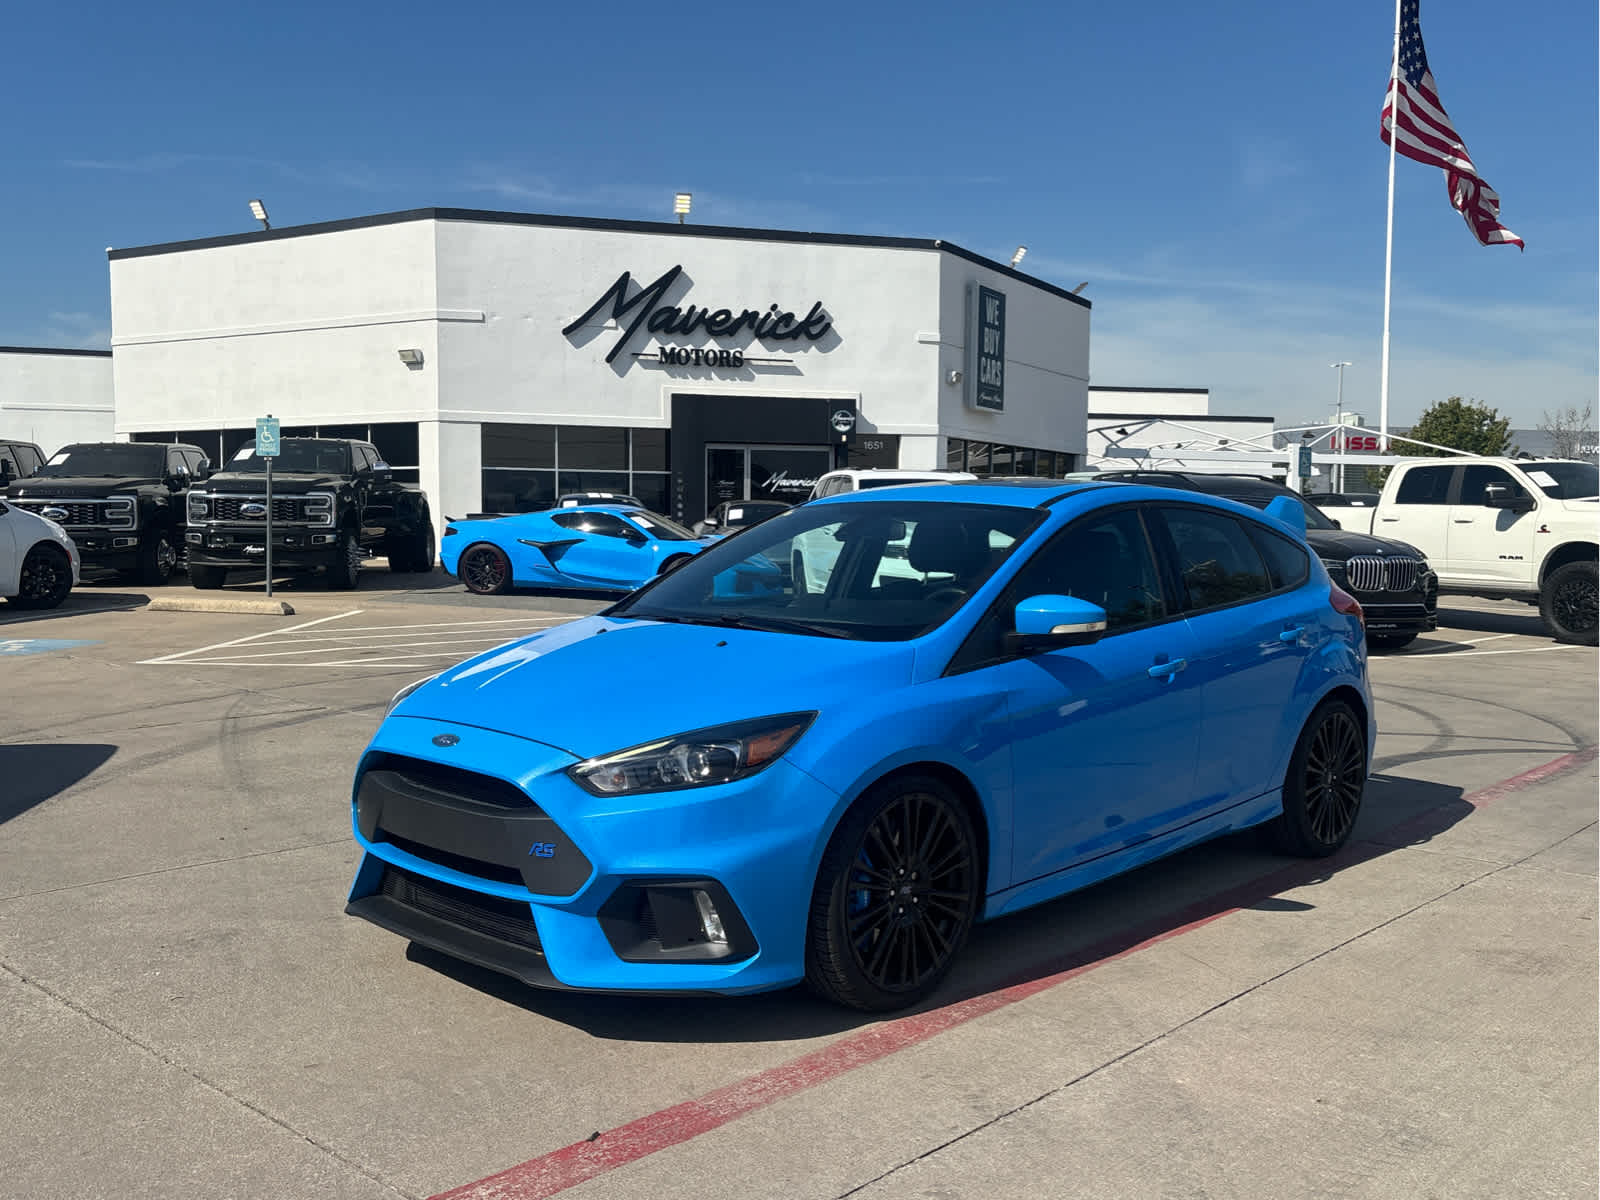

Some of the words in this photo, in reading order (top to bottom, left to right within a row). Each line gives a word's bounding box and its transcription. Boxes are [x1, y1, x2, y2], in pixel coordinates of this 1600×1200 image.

[562, 264, 831, 363] Maverick
[985, 295, 1000, 325] WE
[983, 326, 1001, 356] BUY
[658, 346, 745, 368] MOTORS
[980, 356, 1002, 387] CARS
[863, 440, 884, 450] 1651
[528, 842, 557, 858] RS
